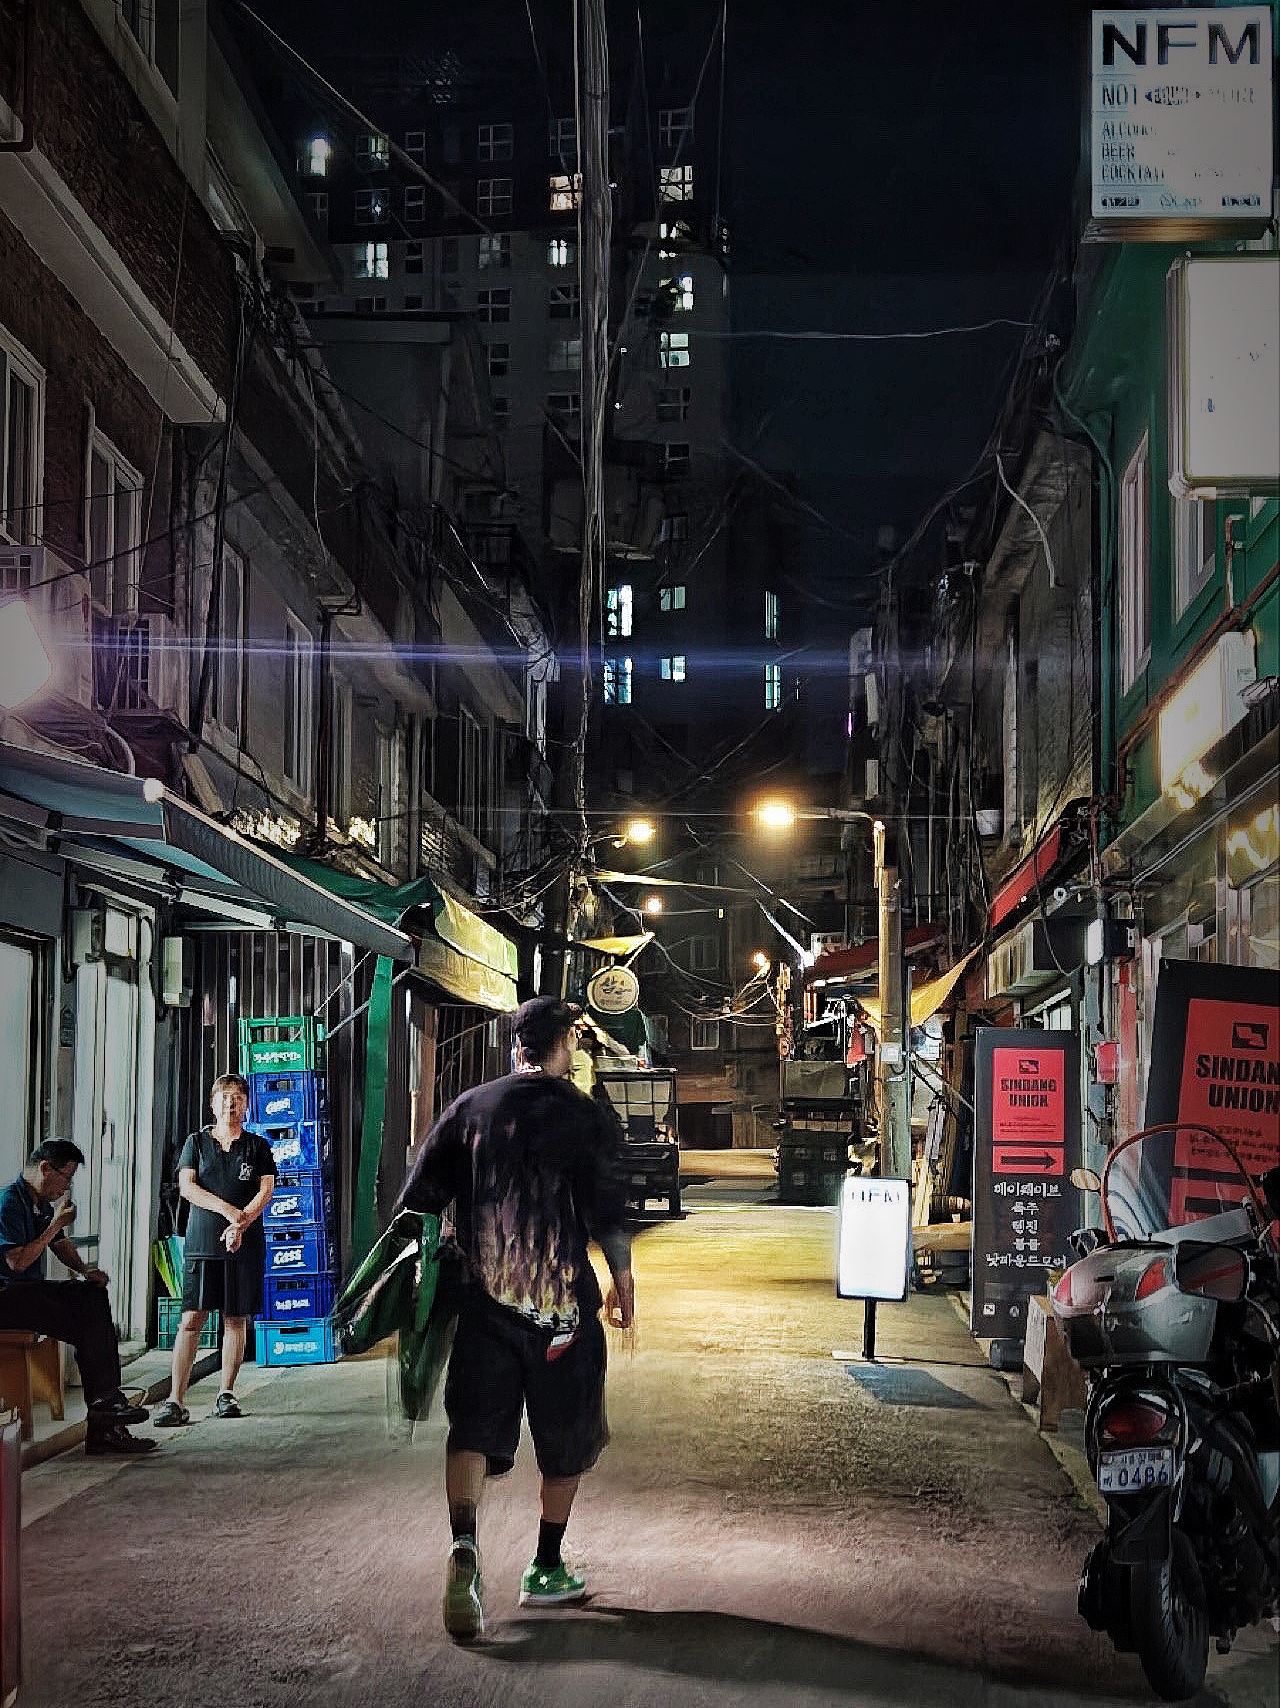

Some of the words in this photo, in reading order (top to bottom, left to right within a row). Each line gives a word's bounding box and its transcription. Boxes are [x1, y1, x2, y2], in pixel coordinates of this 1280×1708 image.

[1102, 20, 1260, 65] NFM
[1001, 1079, 1057, 1092] SINDANG
[1010, 1094, 1048, 1108] UNION
[1209, 1084, 1280, 1114] UNION
[1119, 1463, 1169, 1487] 0486
